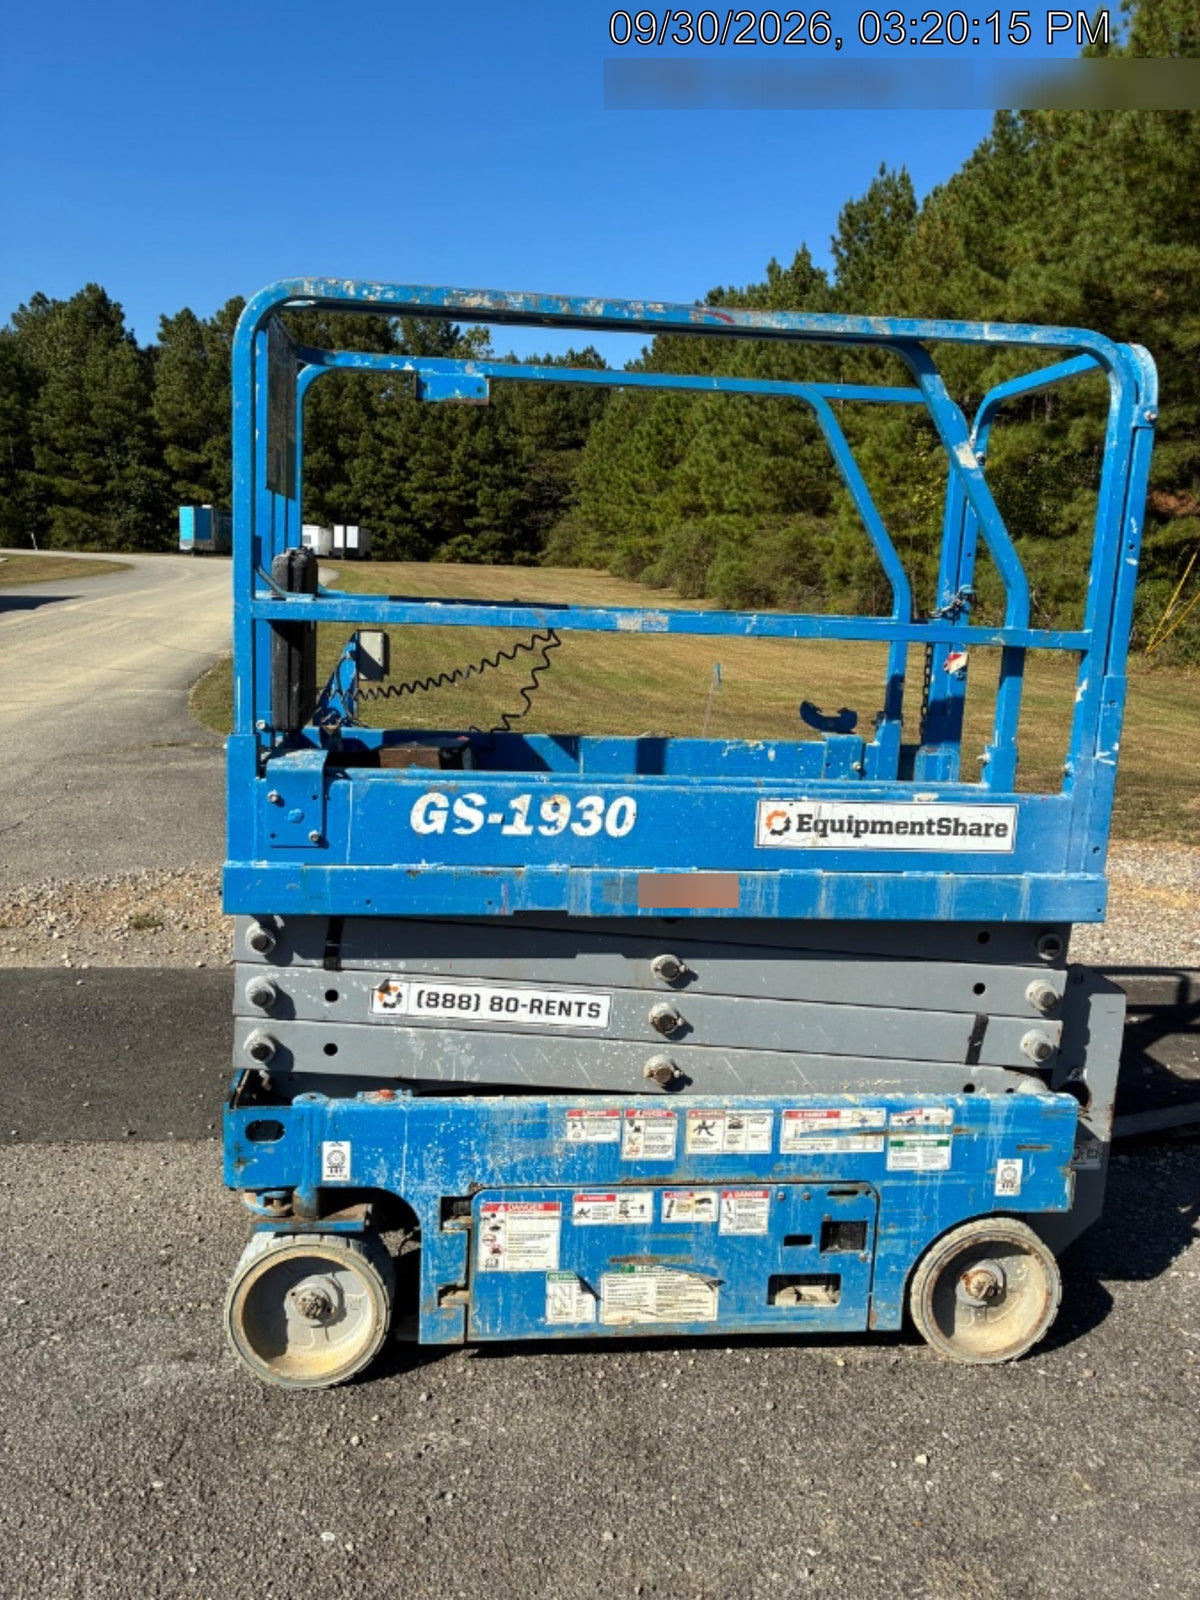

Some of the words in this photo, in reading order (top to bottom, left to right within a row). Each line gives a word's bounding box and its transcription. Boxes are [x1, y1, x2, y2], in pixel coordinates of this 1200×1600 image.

[410, 792, 637, 838] GS-1930
[796, 813, 1008, 839] EquipmentShare
[417, 990, 481, 1012] (888)
[489, 995, 601, 1019] 80-RENTS
[508, 1203, 544, 1211] DANGER
[734, 1190, 763, 1198] DANGER
